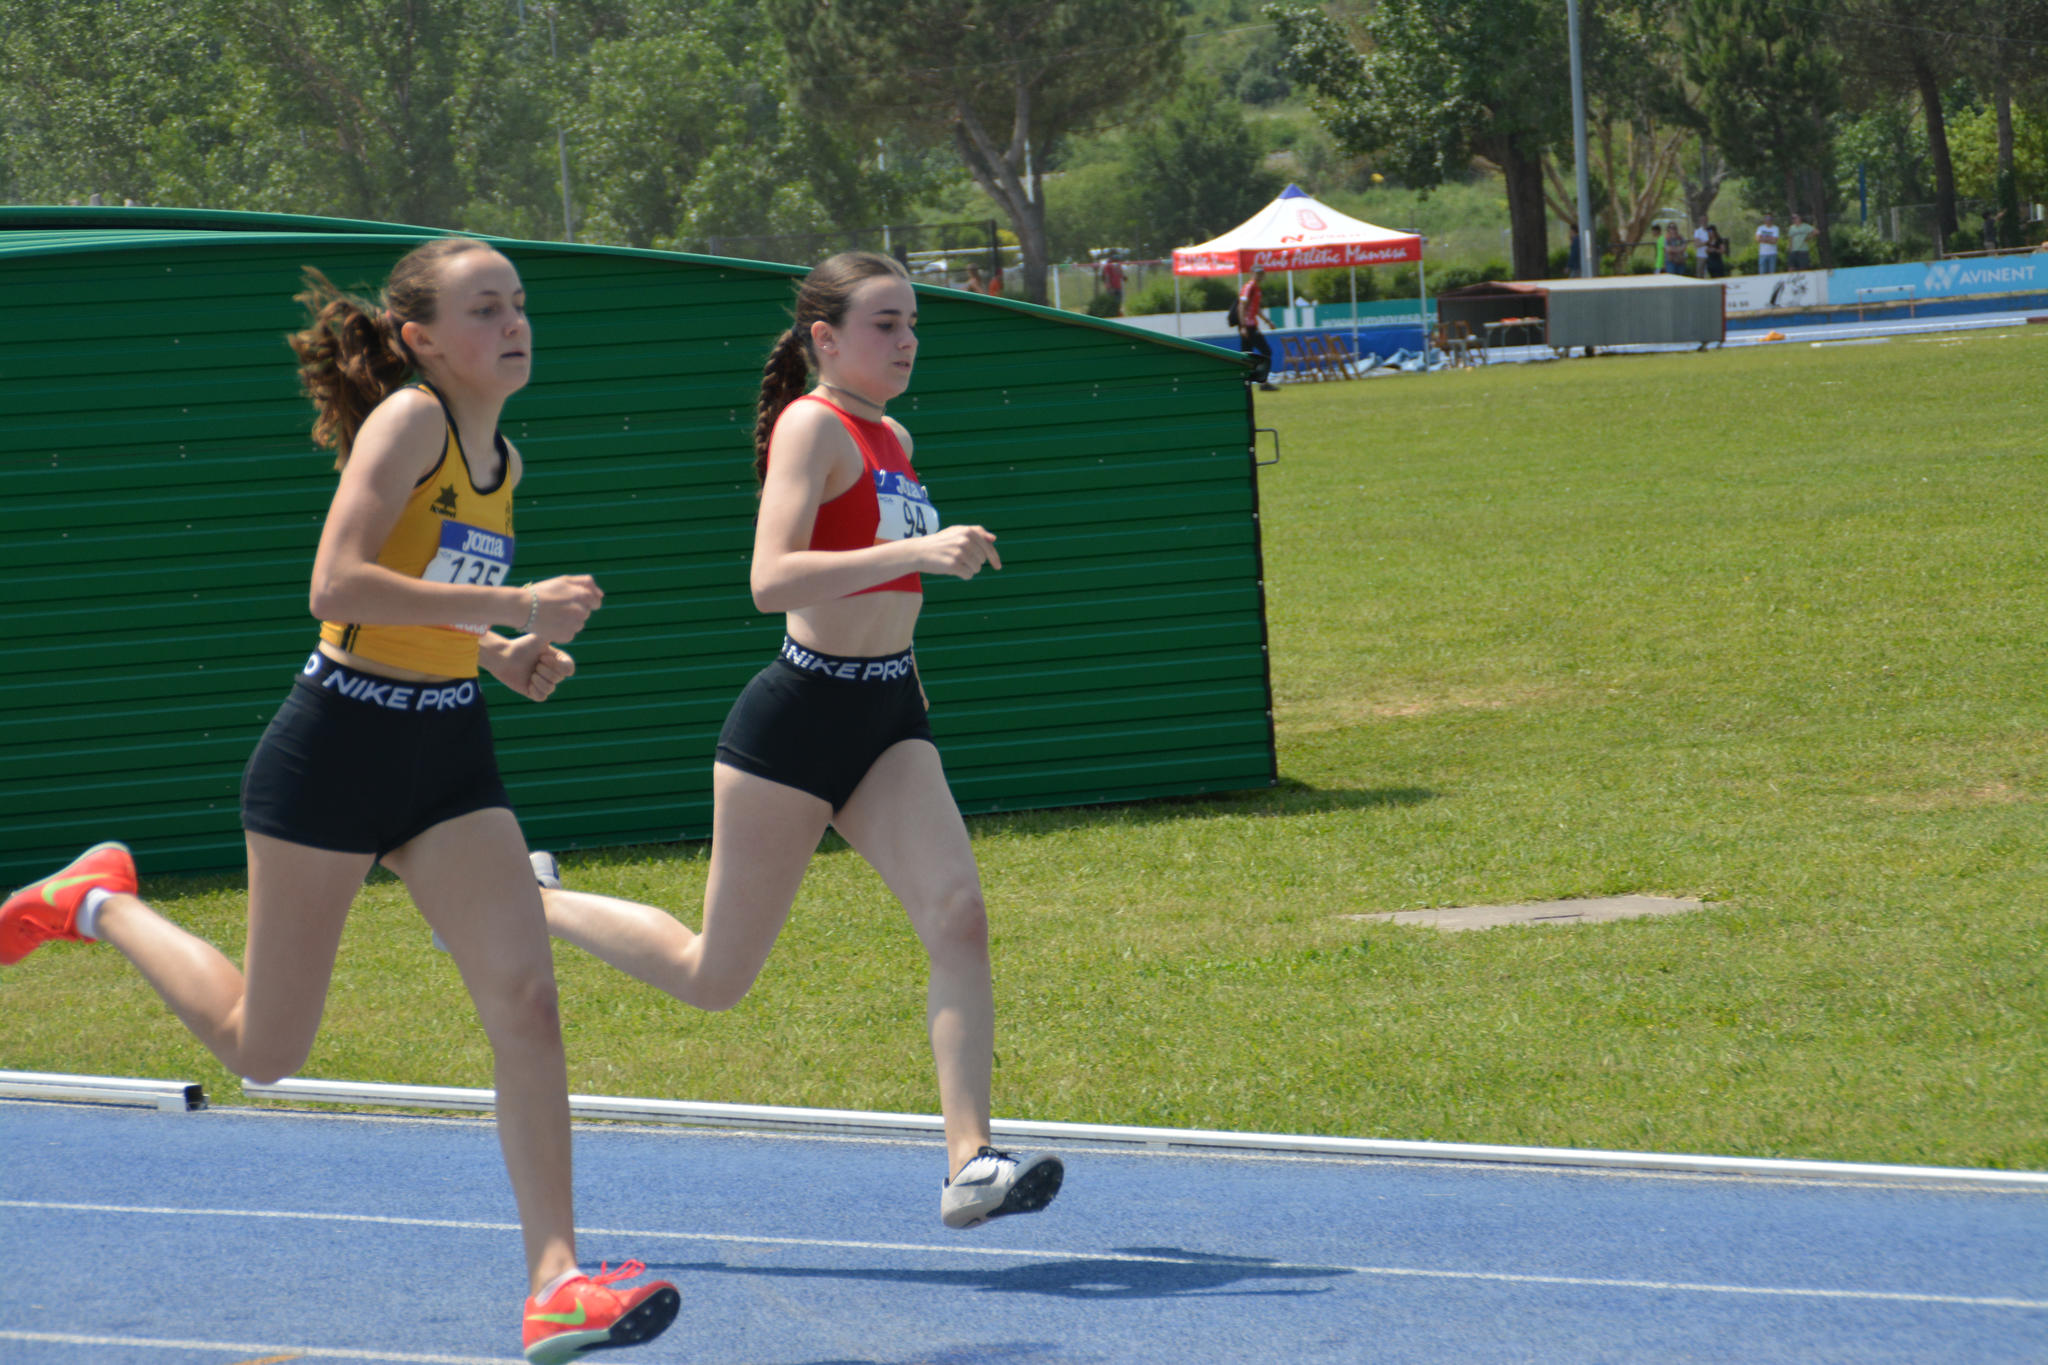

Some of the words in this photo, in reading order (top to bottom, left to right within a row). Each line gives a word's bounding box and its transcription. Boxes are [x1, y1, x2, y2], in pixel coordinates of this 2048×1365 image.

[1254, 249, 1289, 268] Club
[1345, 243, 1407, 264] Manresa
[1959, 264, 2036, 285] AVINENT
[903, 500, 927, 539] 94
[786, 644, 861, 679] NIKE
[861, 655, 909, 681] PRO
[322, 669, 414, 710] NIKE
[416, 681, 474, 712] PRO
